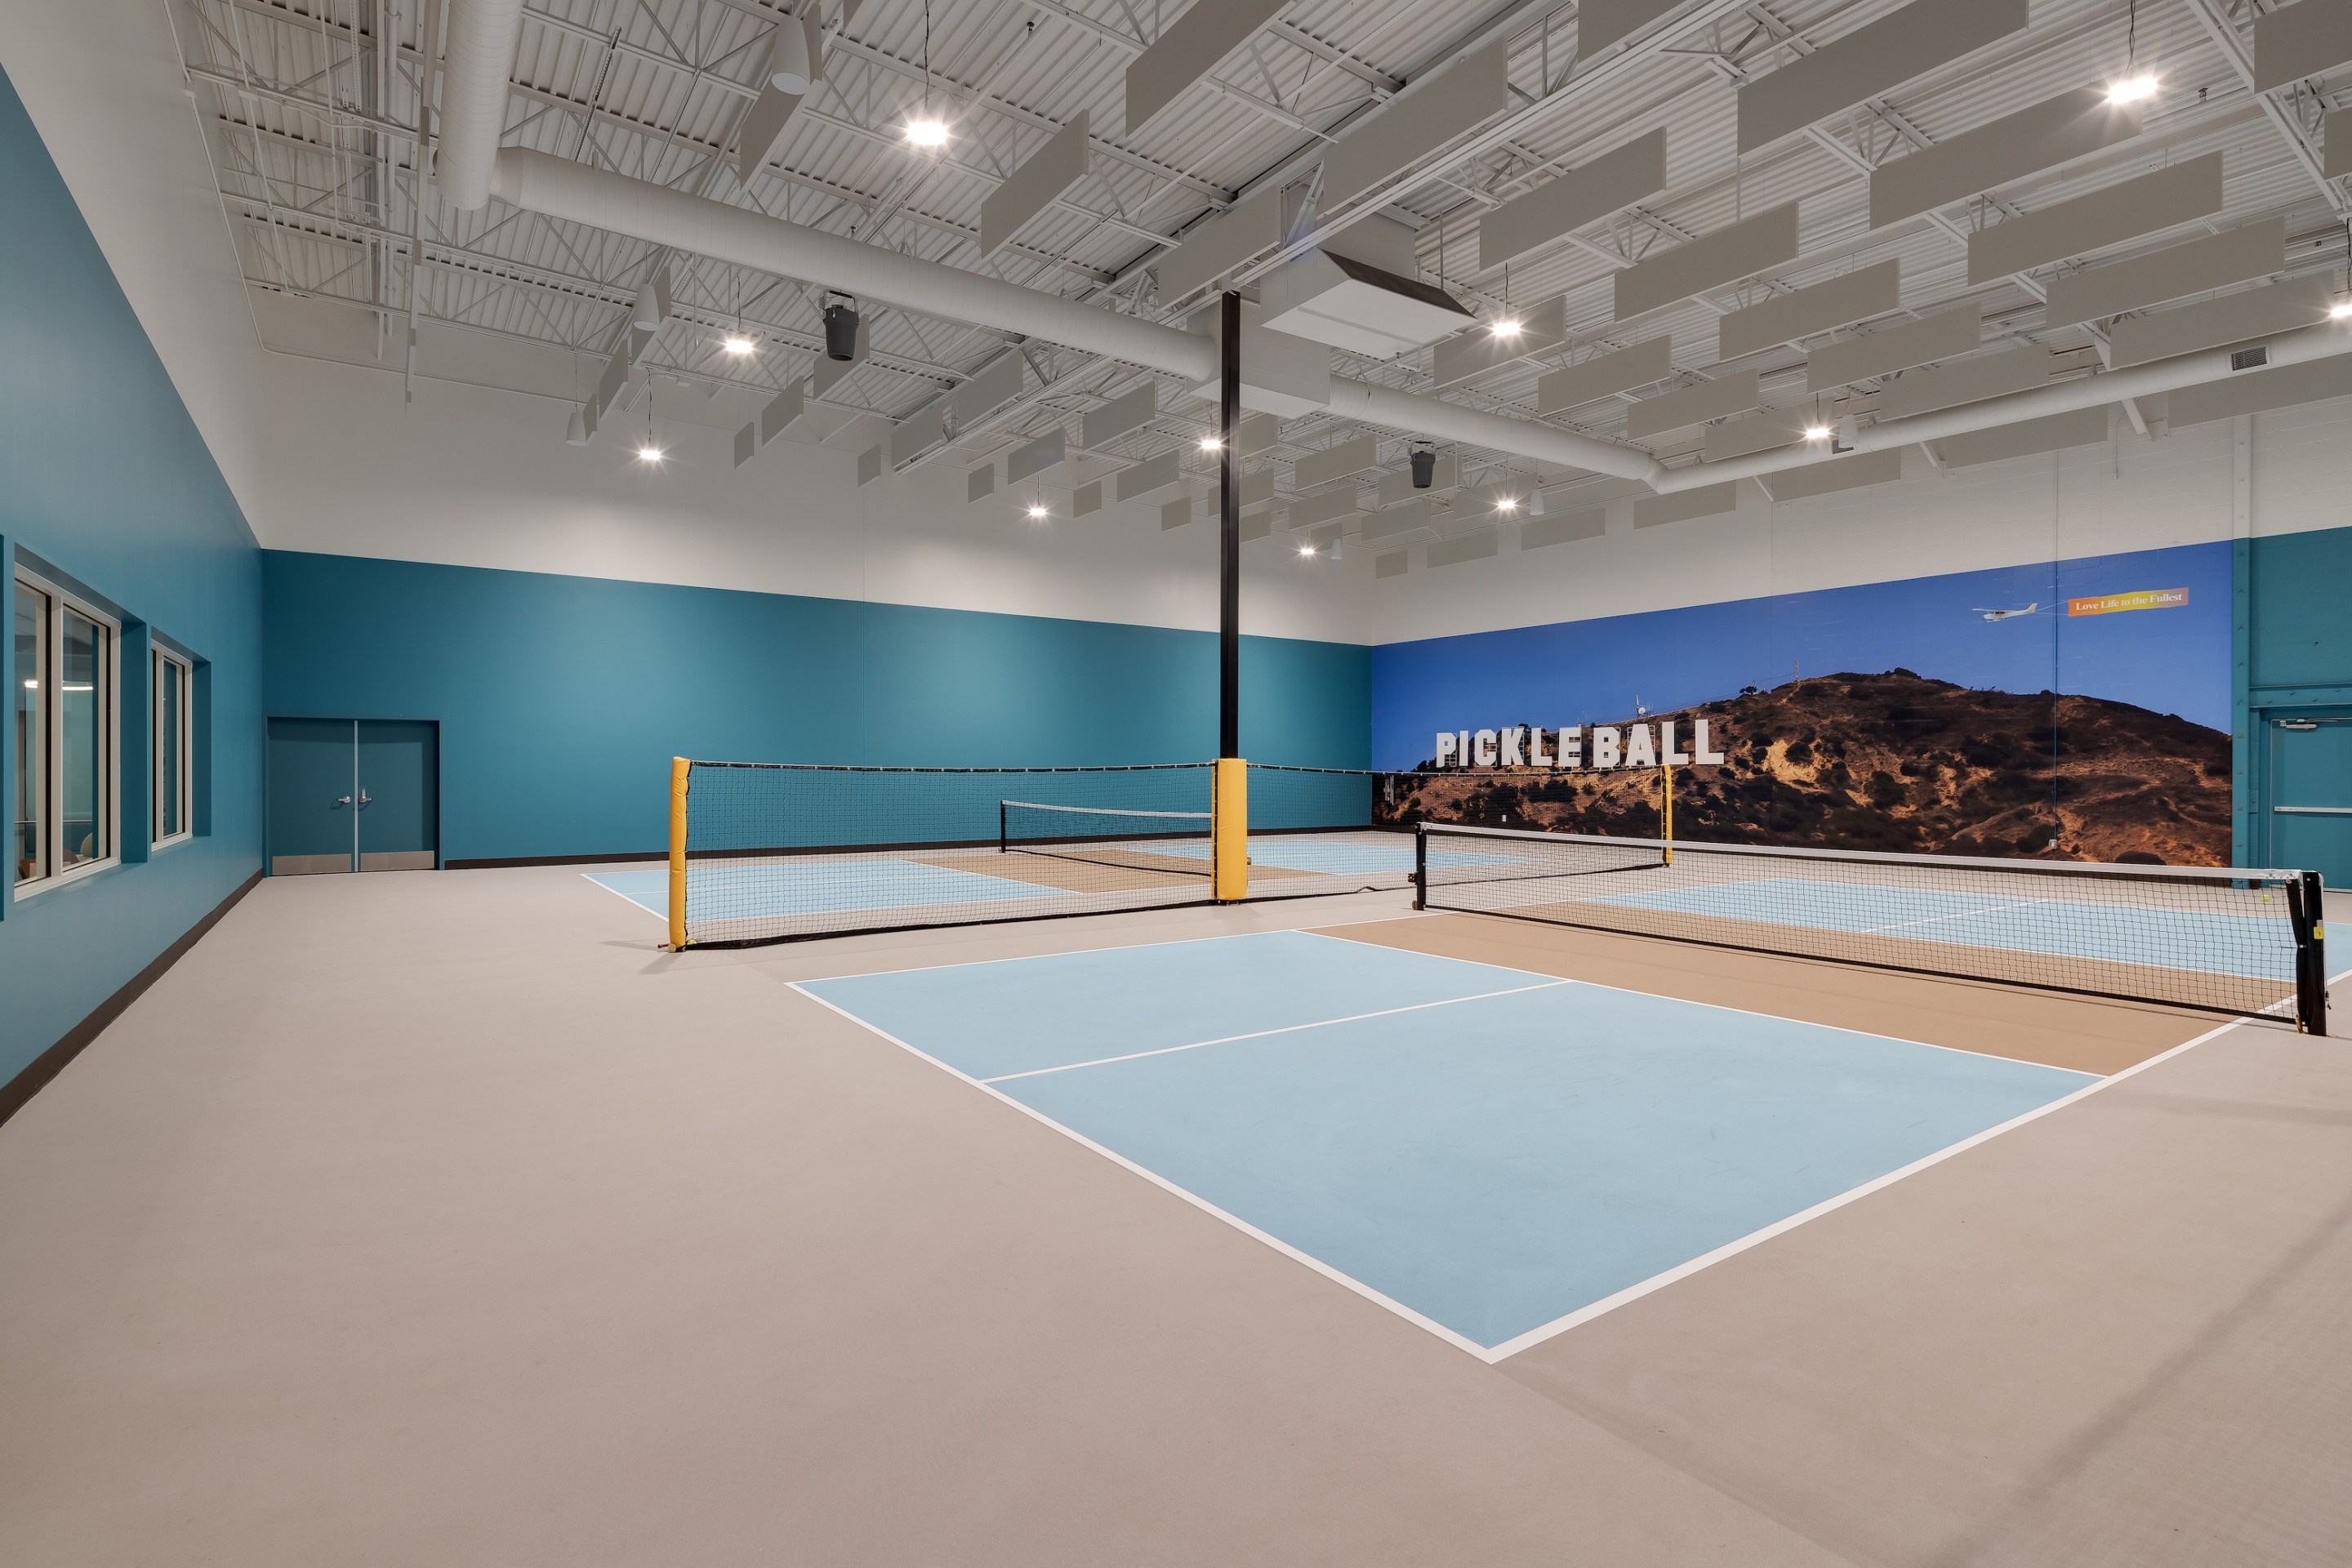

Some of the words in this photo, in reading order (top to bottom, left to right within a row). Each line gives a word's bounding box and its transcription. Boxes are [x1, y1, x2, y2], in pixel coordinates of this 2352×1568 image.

[2075, 603, 2099, 611] Love
[2100, 600, 2118, 609] Life
[2132, 596, 2147, 605] the
[2149, 593, 2182, 604] Fullest
[1436, 719, 1725, 768] PICKLEBALL
